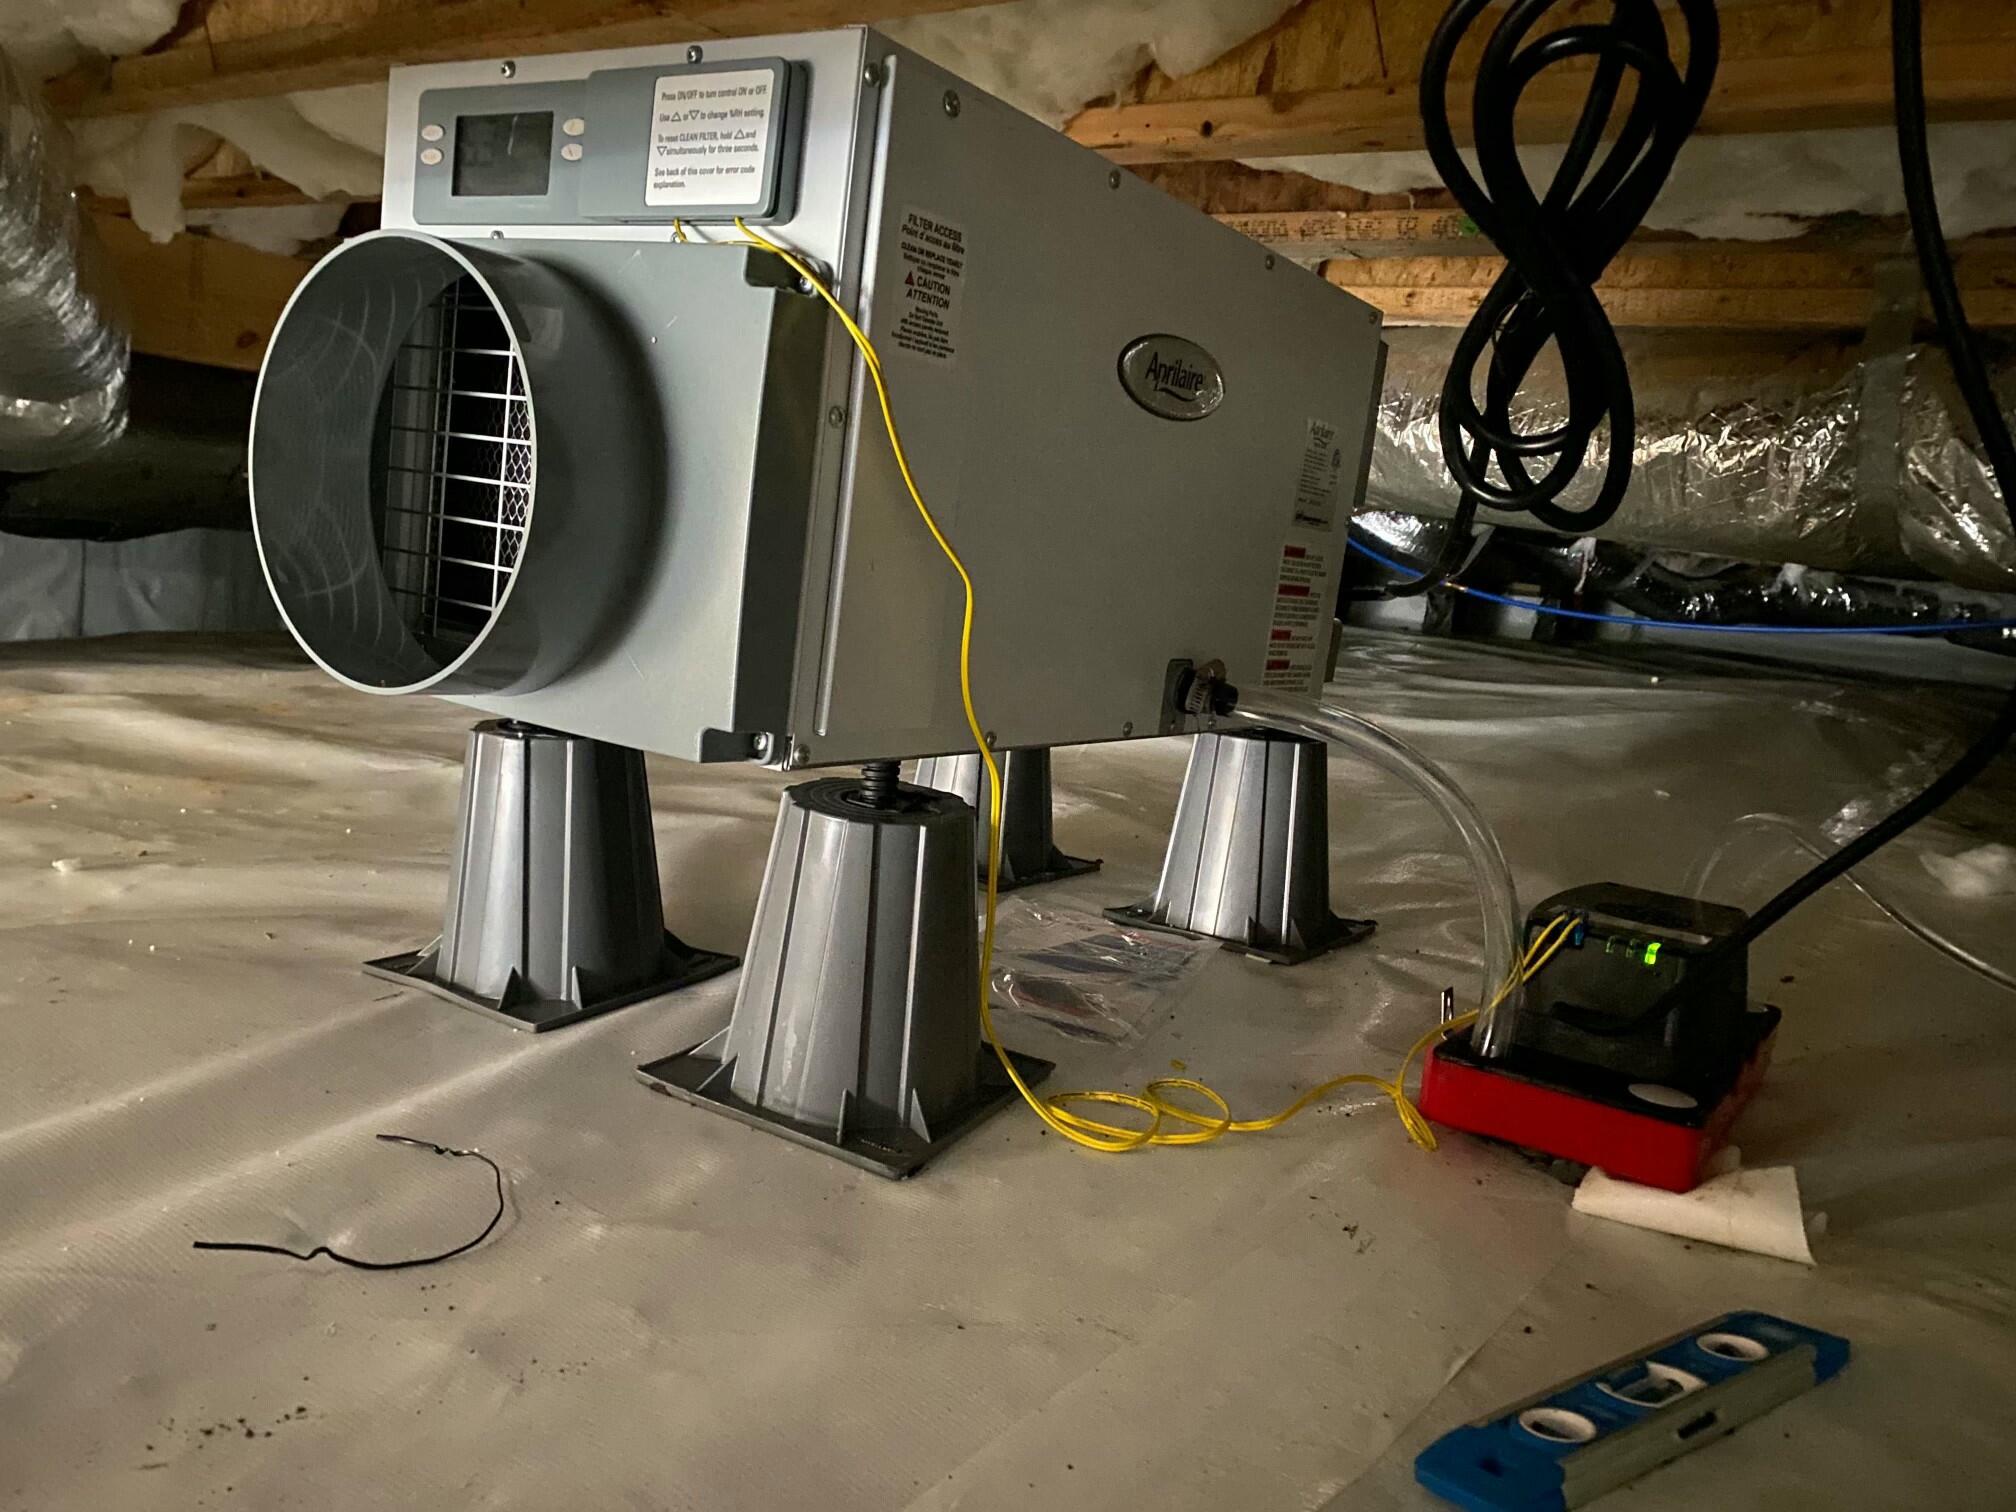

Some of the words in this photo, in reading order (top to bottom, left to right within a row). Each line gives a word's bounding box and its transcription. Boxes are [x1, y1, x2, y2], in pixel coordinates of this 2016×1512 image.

[738, 86, 747, 96] ON
[680, 132, 698, 141] CLEAN
[666, 167, 679, 176] back
[908, 213, 933, 233] FILTER
[934, 223, 962, 243] ACCESS
[917, 275, 951, 296] CAUTION
[906, 287, 951, 311] ATTENTION
[1145, 351, 1204, 392] Aprilaire
